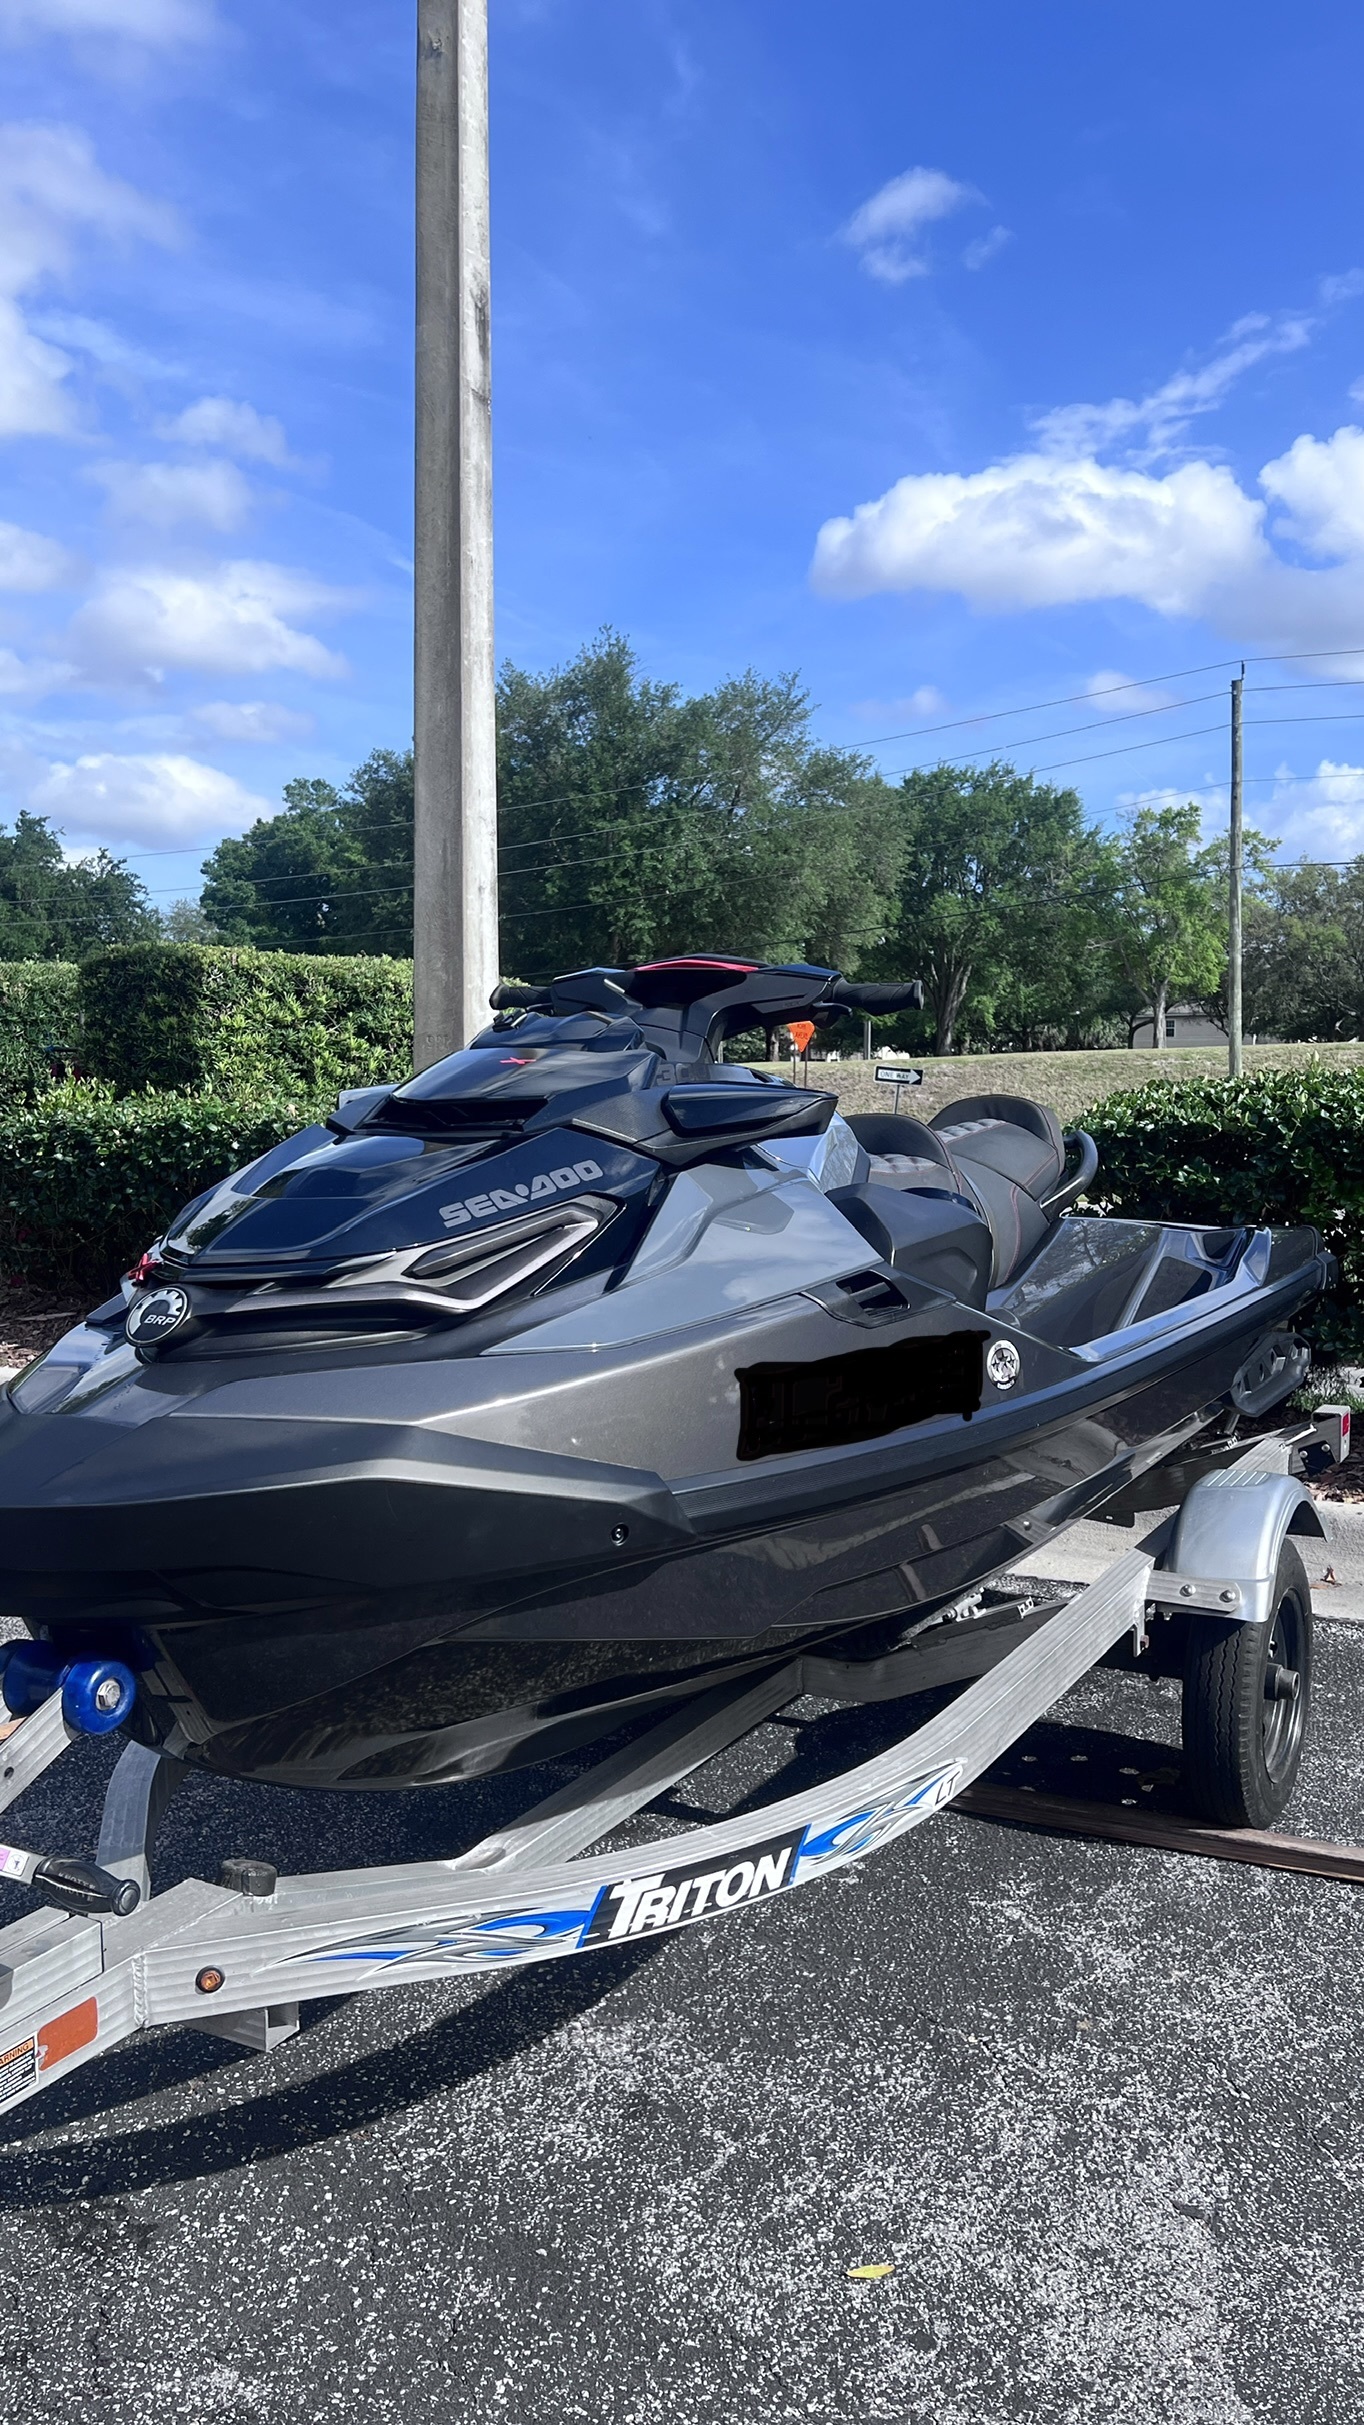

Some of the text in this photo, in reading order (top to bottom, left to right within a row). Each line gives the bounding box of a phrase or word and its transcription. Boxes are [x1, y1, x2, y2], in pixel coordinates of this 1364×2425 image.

[879, 1070, 910, 1080] ONE WAY
[143, 1314, 177, 1326] BRP
[934, 1770, 961, 1806] LT
[607, 1846, 793, 1939] TRITON
